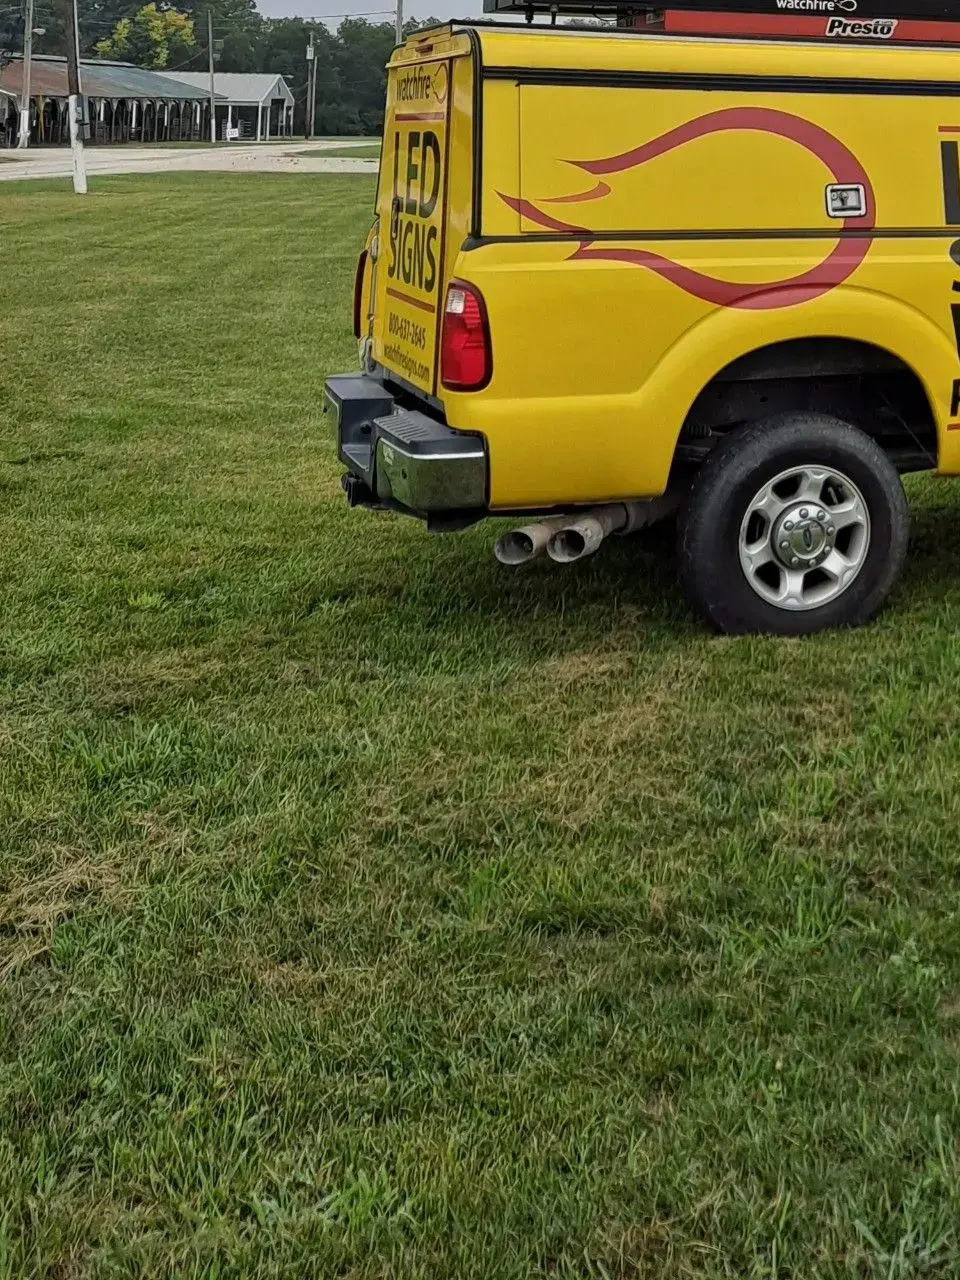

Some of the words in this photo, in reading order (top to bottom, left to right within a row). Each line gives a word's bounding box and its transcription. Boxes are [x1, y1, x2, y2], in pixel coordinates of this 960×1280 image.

[828, 19, 893, 35] Presto
[396, 65, 431, 102] watchfire
[392, 130, 441, 219] LED
[387, 219, 438, 293] SIGNS
[388, 311, 427, 351] 800-637-2645
[383, 343, 431, 383] watchfiresigns.com
